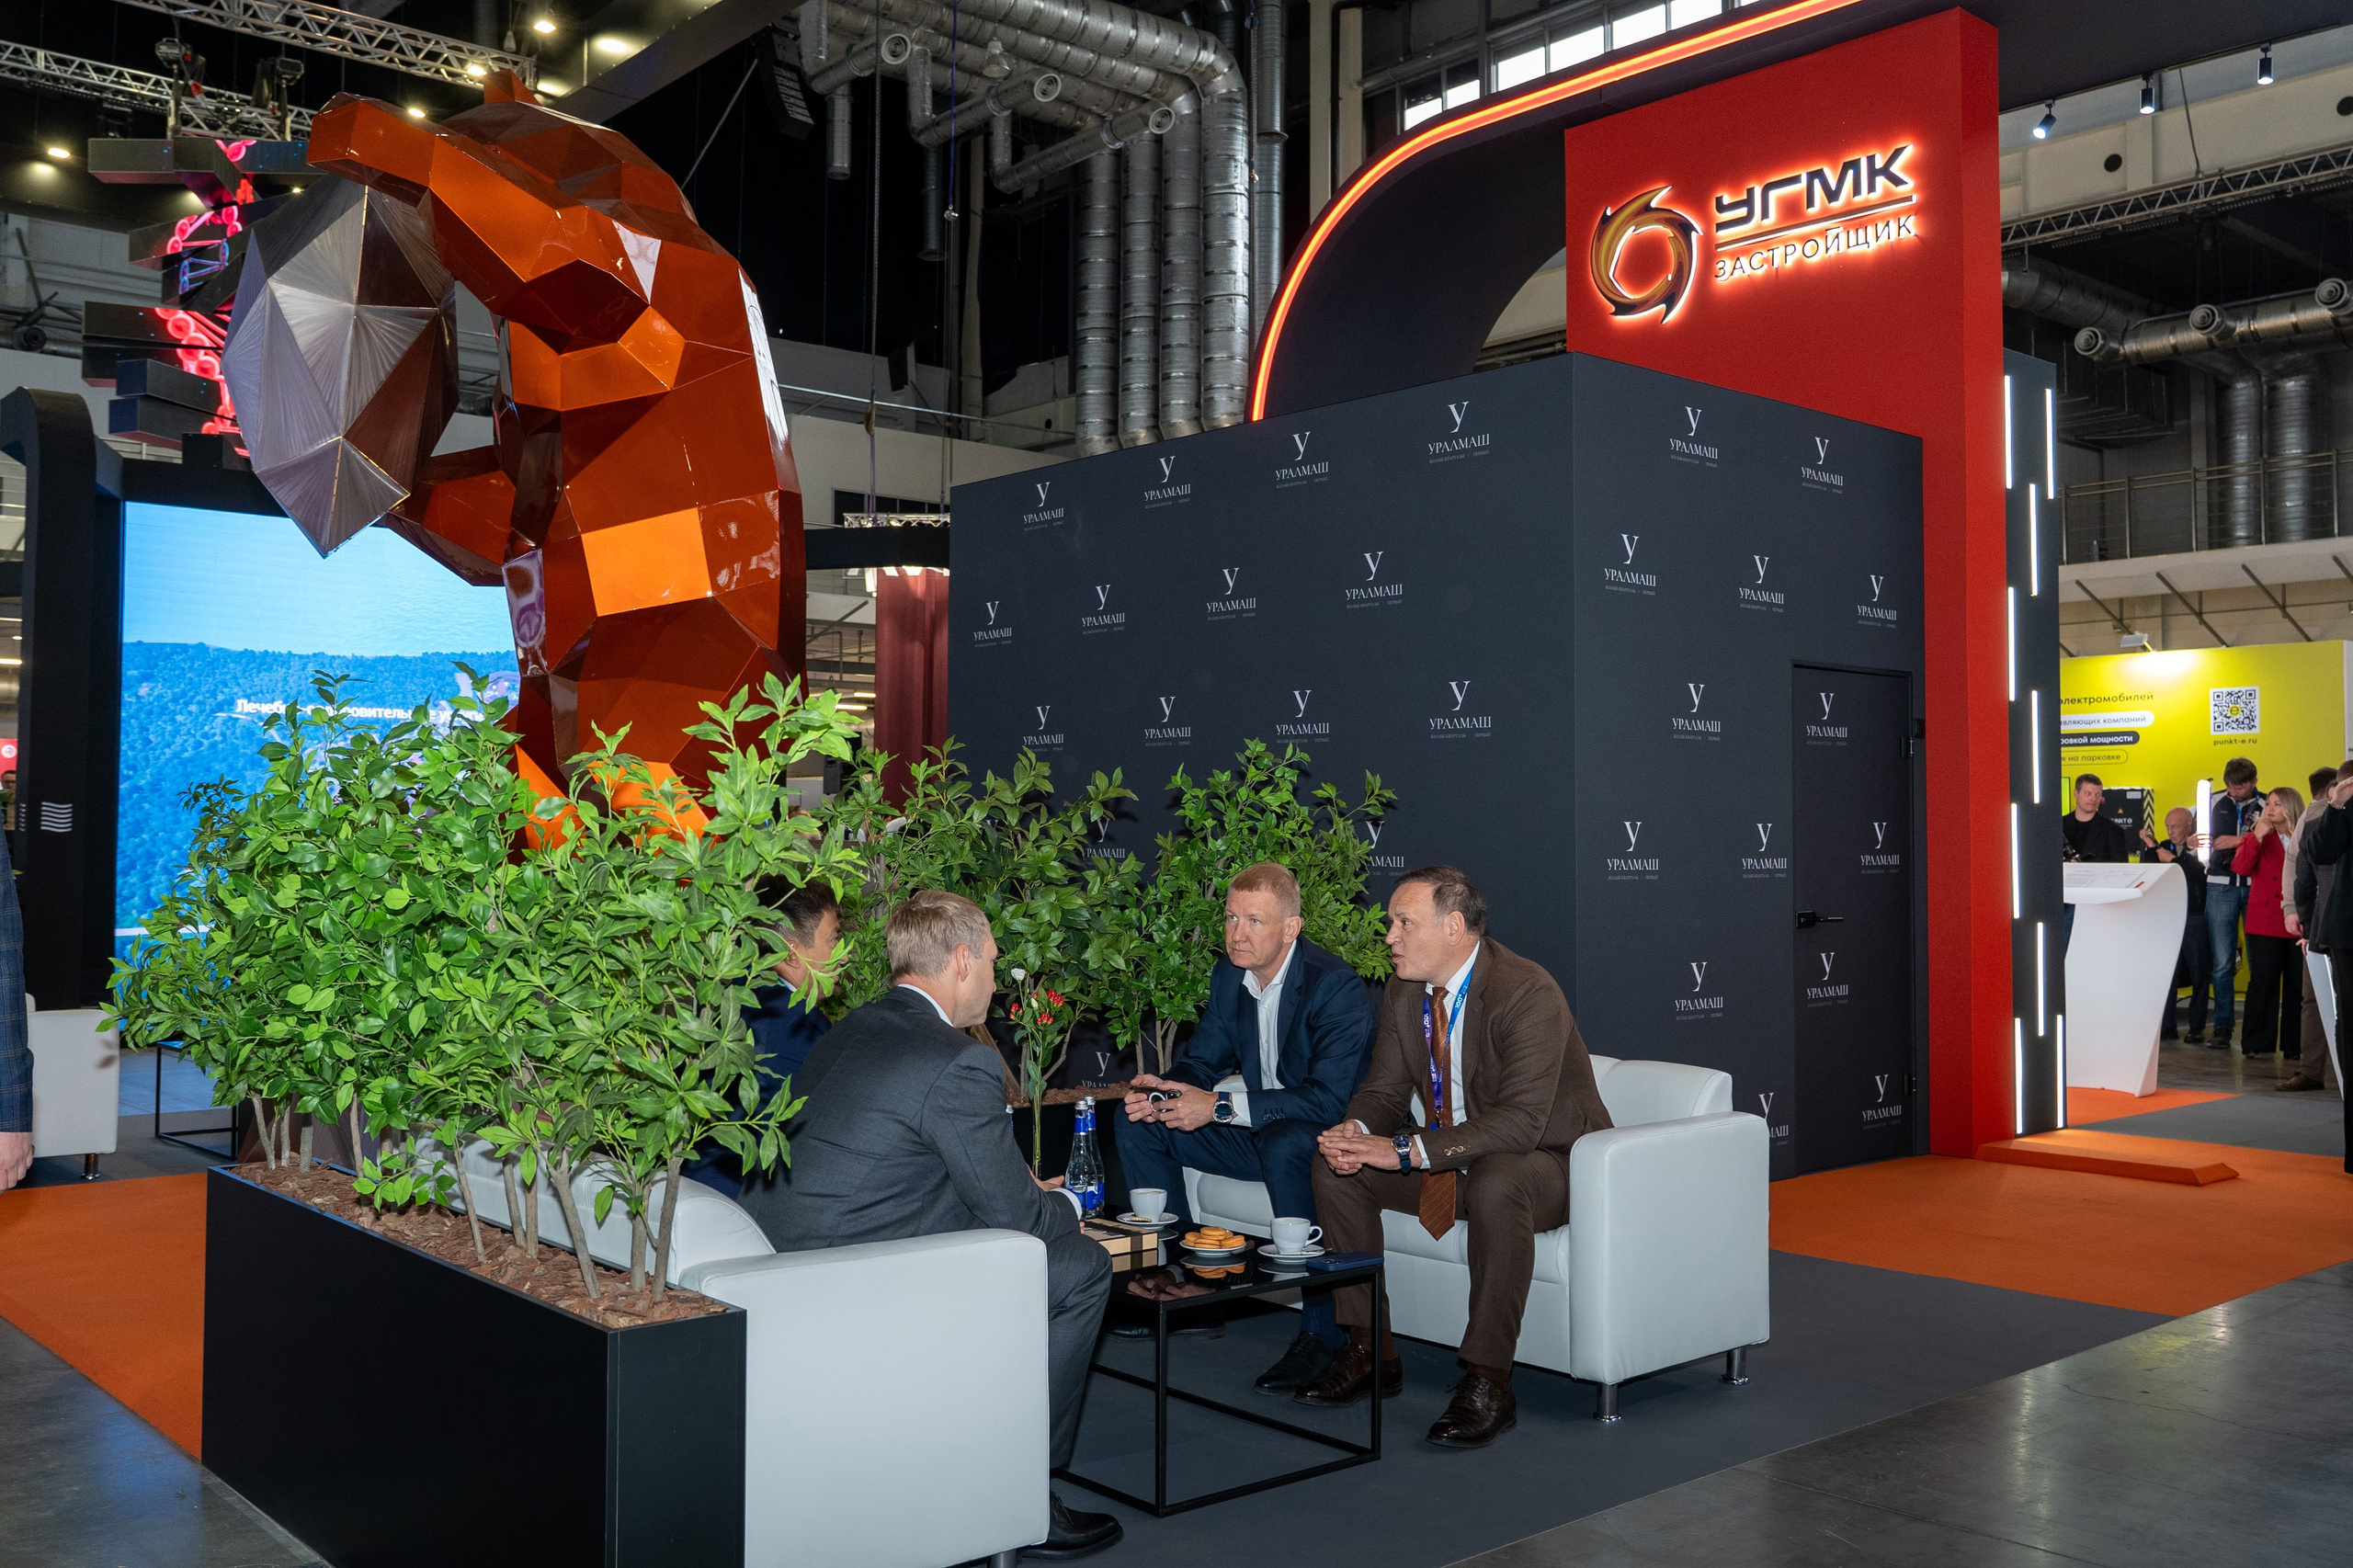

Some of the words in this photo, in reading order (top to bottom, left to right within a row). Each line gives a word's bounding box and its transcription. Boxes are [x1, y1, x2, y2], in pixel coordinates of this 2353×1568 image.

[1715, 144, 1915, 235] УГМК
[1714, 215, 1915, 280] ЗАСТРОЙЩИК
[1428, 434, 1490, 455] УРАЛМАШ
[1670, 438, 1718, 460] УРАЛМАШ
[1276, 461, 1329, 480] УРАЛМАШ
[1802, 467, 1843, 486] УРАЛМАШ
[1144, 483, 1190, 501] УРАЛМАШ
[1024, 507, 1064, 525] УРАЛМАШ
[1605, 568, 1656, 587] УРАЛМАШ
[1346, 584, 1403, 600] УРАЛМАШ
[1739, 587, 1784, 605] УРАЛМАШ
[1207, 597, 1256, 613] УРАЛМАШ
[1082, 613, 1125, 627] УРАЛМАШ
[1858, 605, 1896, 621] УРАЛМАШ
[973, 627, 1012, 641] УРАЛМАШ
[1429, 716, 1492, 730] УРАЛМАШ
[1672, 718, 1721, 733] УРАЛМАШ
[2103, 715, 2146, 725] компаний
[1144, 727, 1191, 739] УРАЛМАШ
[1276, 722, 1329, 735] УРАЛМАШ
[1806, 725, 1847, 738] УРАЛМАШ
[1023, 733, 1064, 745] УРАЛМАШ
[2089, 735, 2133, 744] мощности
[2213, 738, 2257, 746] punkt-e.ru
[2081, 754, 2121, 763] парковке
[1608, 858, 1659, 870] УРАЛМАШ
[1742, 858, 1787, 869] УРАЛМАШ
[1860, 855, 1900, 865] УРАЛМАШ
[1807, 984, 1848, 998] УРАЛМАШ
[1676, 996, 1723, 1012] УРАЛМАШ
[1862, 1105, 1902, 1121] УРАЛМАШ
